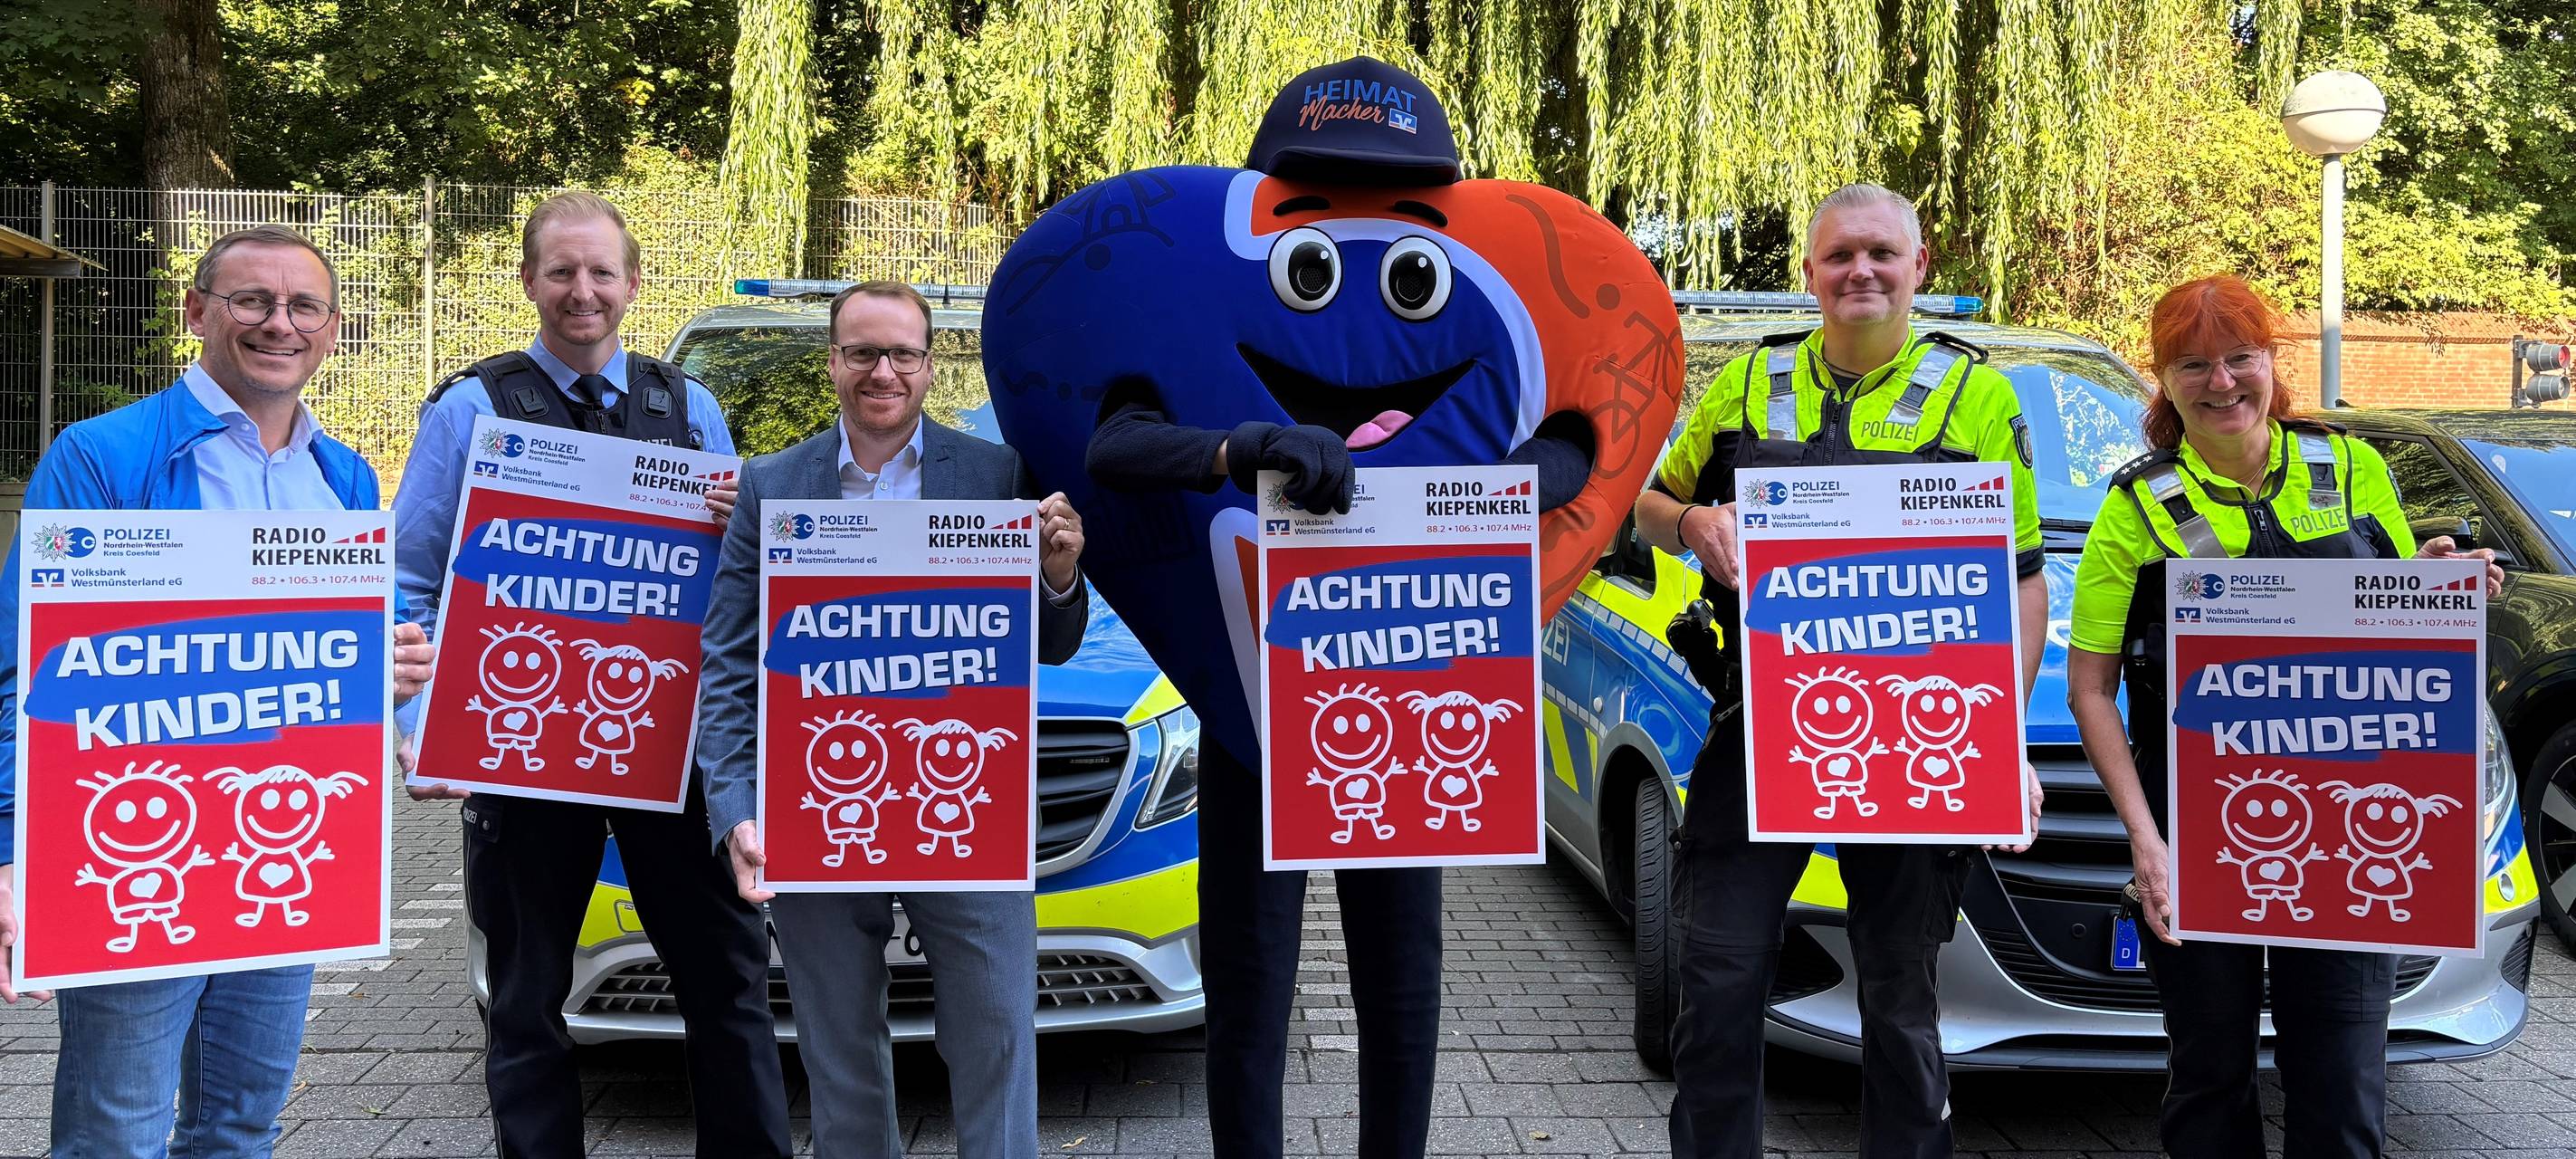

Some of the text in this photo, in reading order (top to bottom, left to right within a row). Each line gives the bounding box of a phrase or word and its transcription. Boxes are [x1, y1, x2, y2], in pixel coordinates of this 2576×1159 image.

[1304, 80, 1417, 112] HEIMAT
[1299, 95, 1385, 130] Macher
[1861, 421, 1919, 443] POLIZEI
[530, 438, 578, 455] POLIZEI
[529, 455, 568, 466] Kreis Coesfeld
[530, 449, 586, 463] Nordrhein-Westfalen
[503, 465, 542, 477] Volksbank
[634, 455, 690, 476] RADIO
[501, 473, 580, 492] Westmünsterland eG
[632, 472, 718, 496] KIEPENKE
[1426, 482, 1483, 497] RADIO
[1792, 481, 1840, 491] POLIZEI
[1900, 477, 1956, 493] RADIO
[629, 493, 647, 503] 88.2
[656, 497, 678, 507] 106.3
[1426, 500, 1531, 516] KIEPENKERL
[1901, 494, 2005, 510] KIEPENKERL
[819, 515, 868, 525] POLIZEI
[929, 515, 985, 530] RADIO
[1771, 520, 1838, 528] Westmünsterland
[2290, 508, 2347, 536] POLIZE
[103, 528, 170, 541] POLIZEI
[253, 527, 326, 544] RADIO
[1294, 527, 1362, 535] Westmünsterland
[479, 517, 700, 578] ACHTUNG
[929, 533, 1032, 548] KIEPENKERL
[253, 548, 386, 566] KIEPENKERL
[72, 568, 127, 577] Volksbank
[252, 575, 386, 585] 88.2 106.3 107.4 MHz
[2230, 575, 2285, 585] POLIZEI
[72, 577, 183, 588] Westmünsterland eG
[1766, 563, 1989, 599] ACHTUNG
[2354, 575, 2421, 590] RADIO
[485, 573, 681, 617] KINDER!
[1286, 572, 1511, 611] ACHTUNG
[2354, 594, 2477, 609] KIEPENKERL
[786, 604, 1010, 639] ACHTUNG
[2388, 618, 2414, 627] 106.3
[2453, 619, 2477, 627] MHz
[1780, 605, 1979, 656] KINDER!
[1301, 617, 1500, 673] KINDER!
[56, 629, 359, 678] ACHTUNG
[799, 647, 997, 699] KINDER!
[2196, 664, 2452, 703] ACHTUNG
[75, 679, 342, 752] KINDER!
[2211, 712, 2438, 756] KINDER!
[2122, 947, 2131, 959] D
